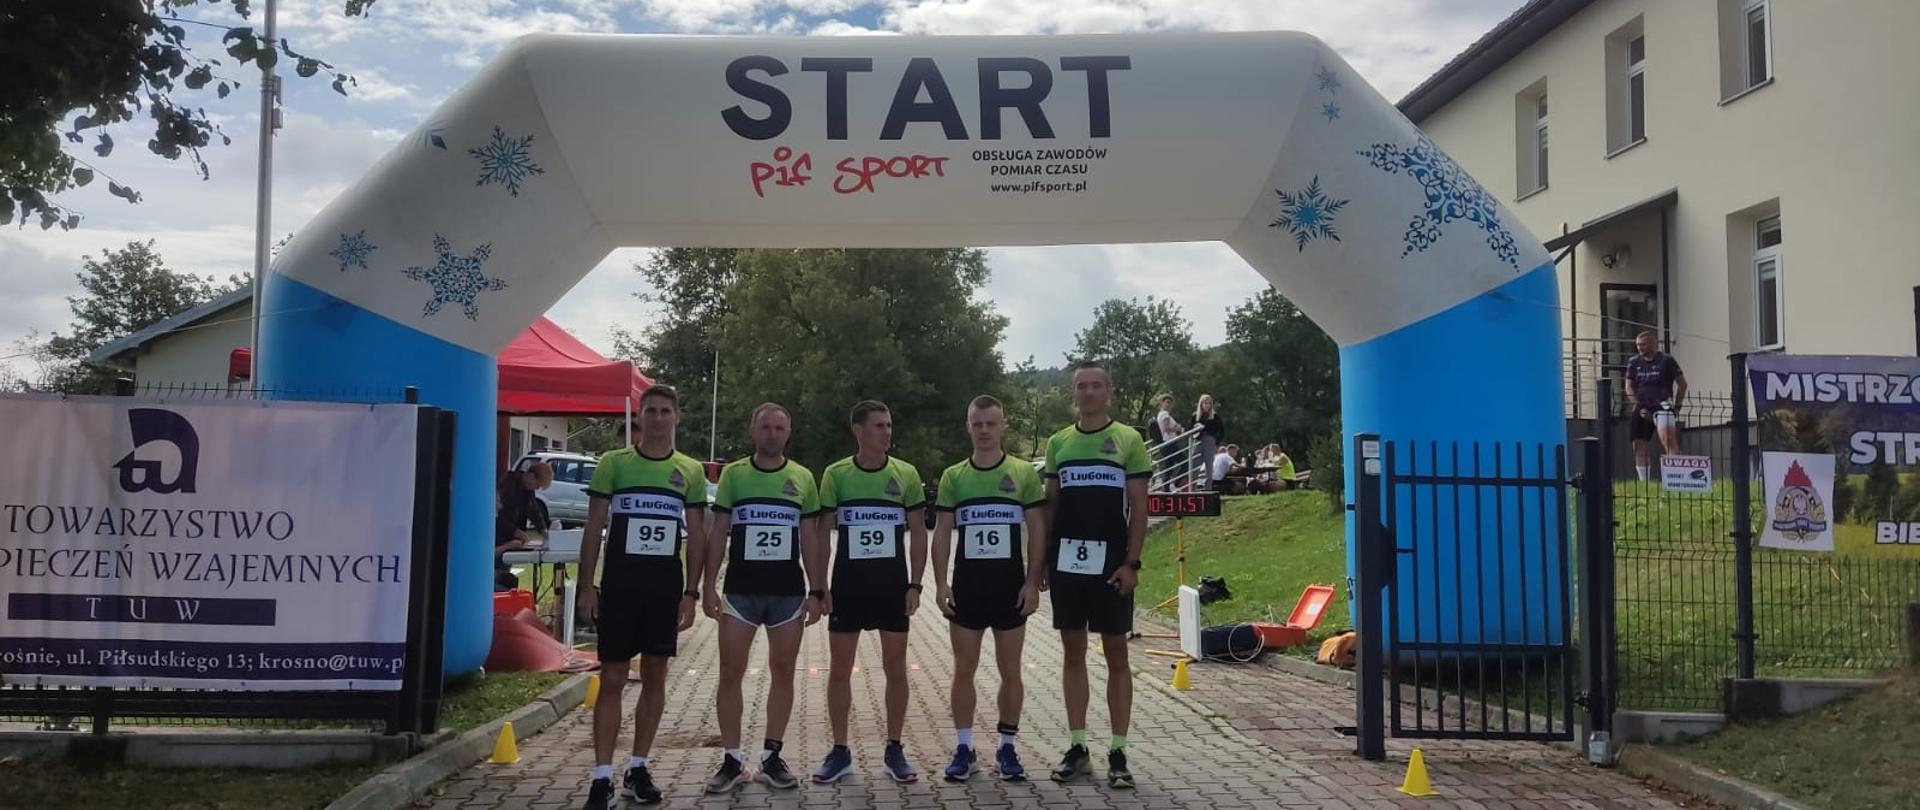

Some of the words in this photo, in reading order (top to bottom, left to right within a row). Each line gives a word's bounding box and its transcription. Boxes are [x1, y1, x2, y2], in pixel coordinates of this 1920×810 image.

[721, 55, 1131, 140] START
[972, 150, 1033, 161] OBSŁUGA
[1036, 145, 1107, 160] ZAWODÓW
[833, 154, 951, 194] SPORT
[991, 164, 1042, 176] POMIAR
[1045, 163, 1088, 175] CZASU
[990, 180, 1088, 194] www.pifsport.pl
[4, 503, 295, 541] TOWARZYSTWO
[639, 525, 666, 542] 95
[756, 531, 782, 547] 25
[860, 530, 884, 546] 59
[975, 530, 1000, 546] 16
[1076, 545, 1088, 561] 8
[148, 551, 402, 590] WZAJEMNYCH
[0, 647, 61, 666] ośnie,
[67, 648, 92, 665] ul.
[98, 649, 219, 672] Piłsudskiego
[227, 653, 253, 671] 13;
